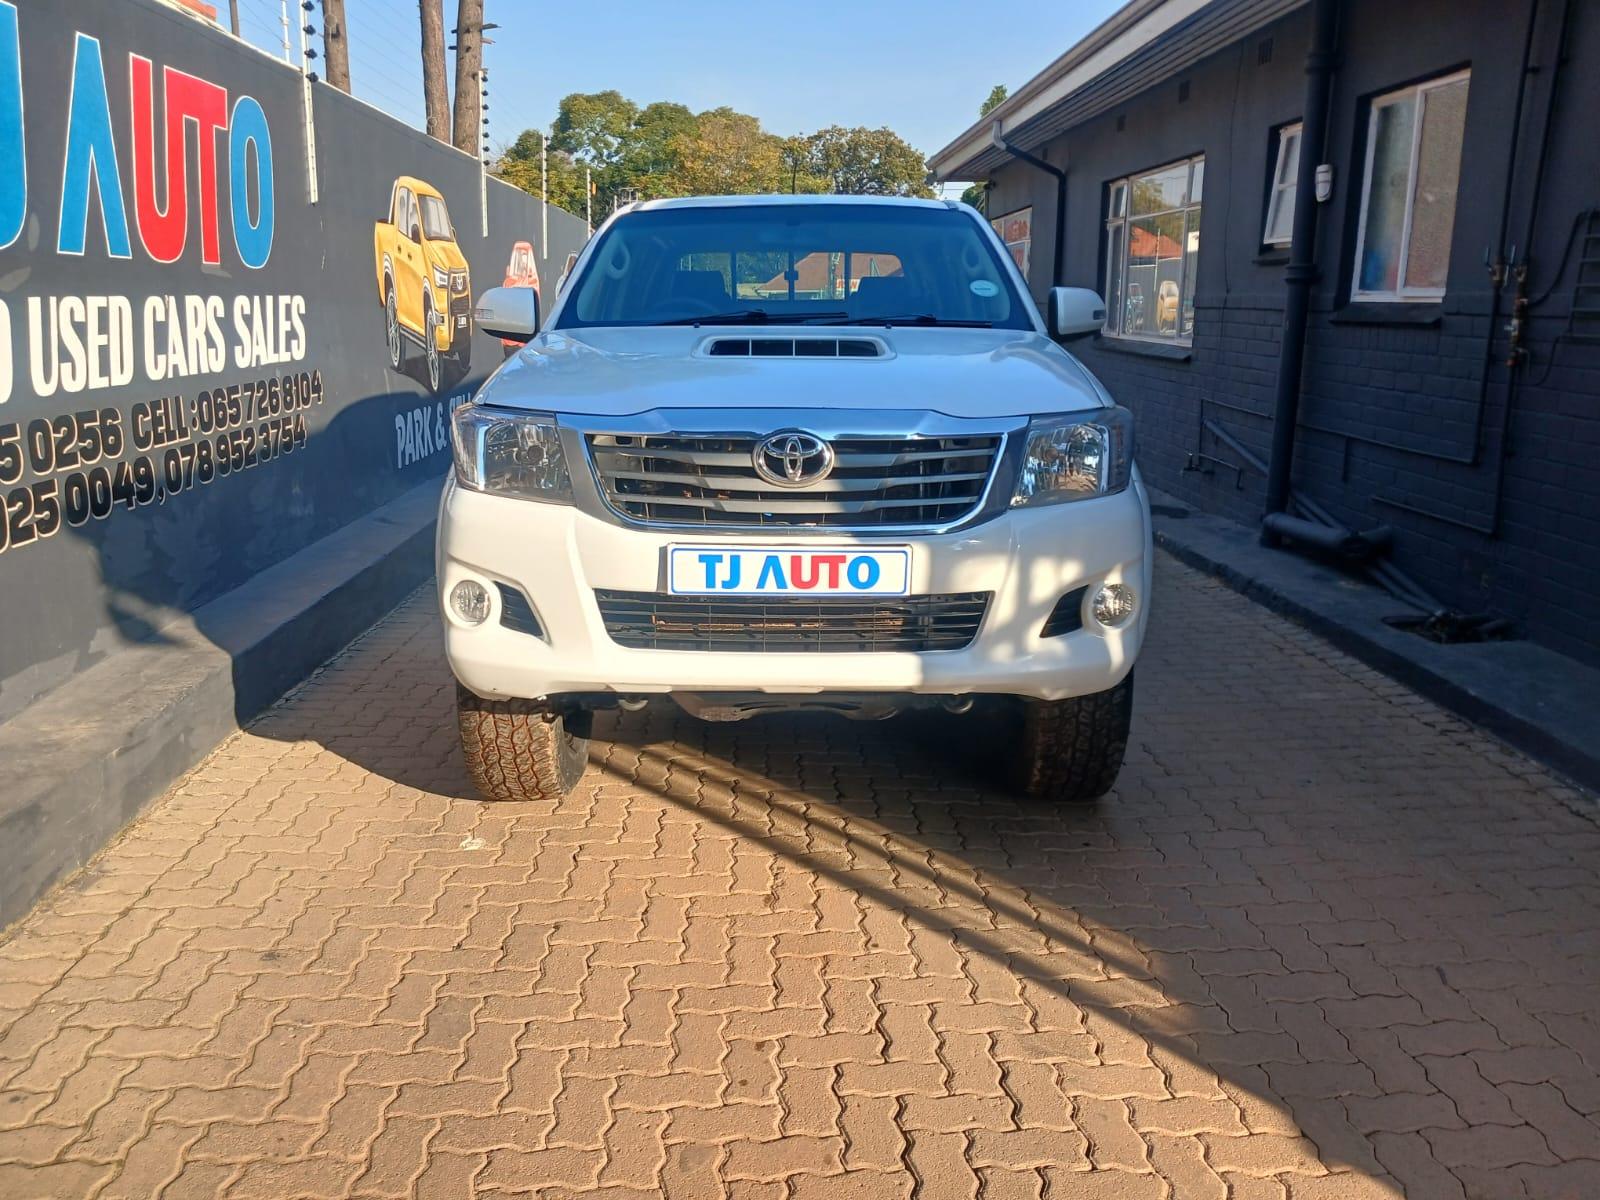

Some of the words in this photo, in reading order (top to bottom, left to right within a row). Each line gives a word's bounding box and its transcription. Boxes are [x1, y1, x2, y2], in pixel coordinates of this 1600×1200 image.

[56, 30, 274, 269] AUTO
[27, 295, 134, 397] USED
[233, 295, 306, 369] SALES
[27, 407, 124, 476] 0256
[395, 405, 434, 469] PARK
[435, 402, 447, 451] &
[698, 554, 741, 590] TJ
[756, 554, 880, 590] AUTO
